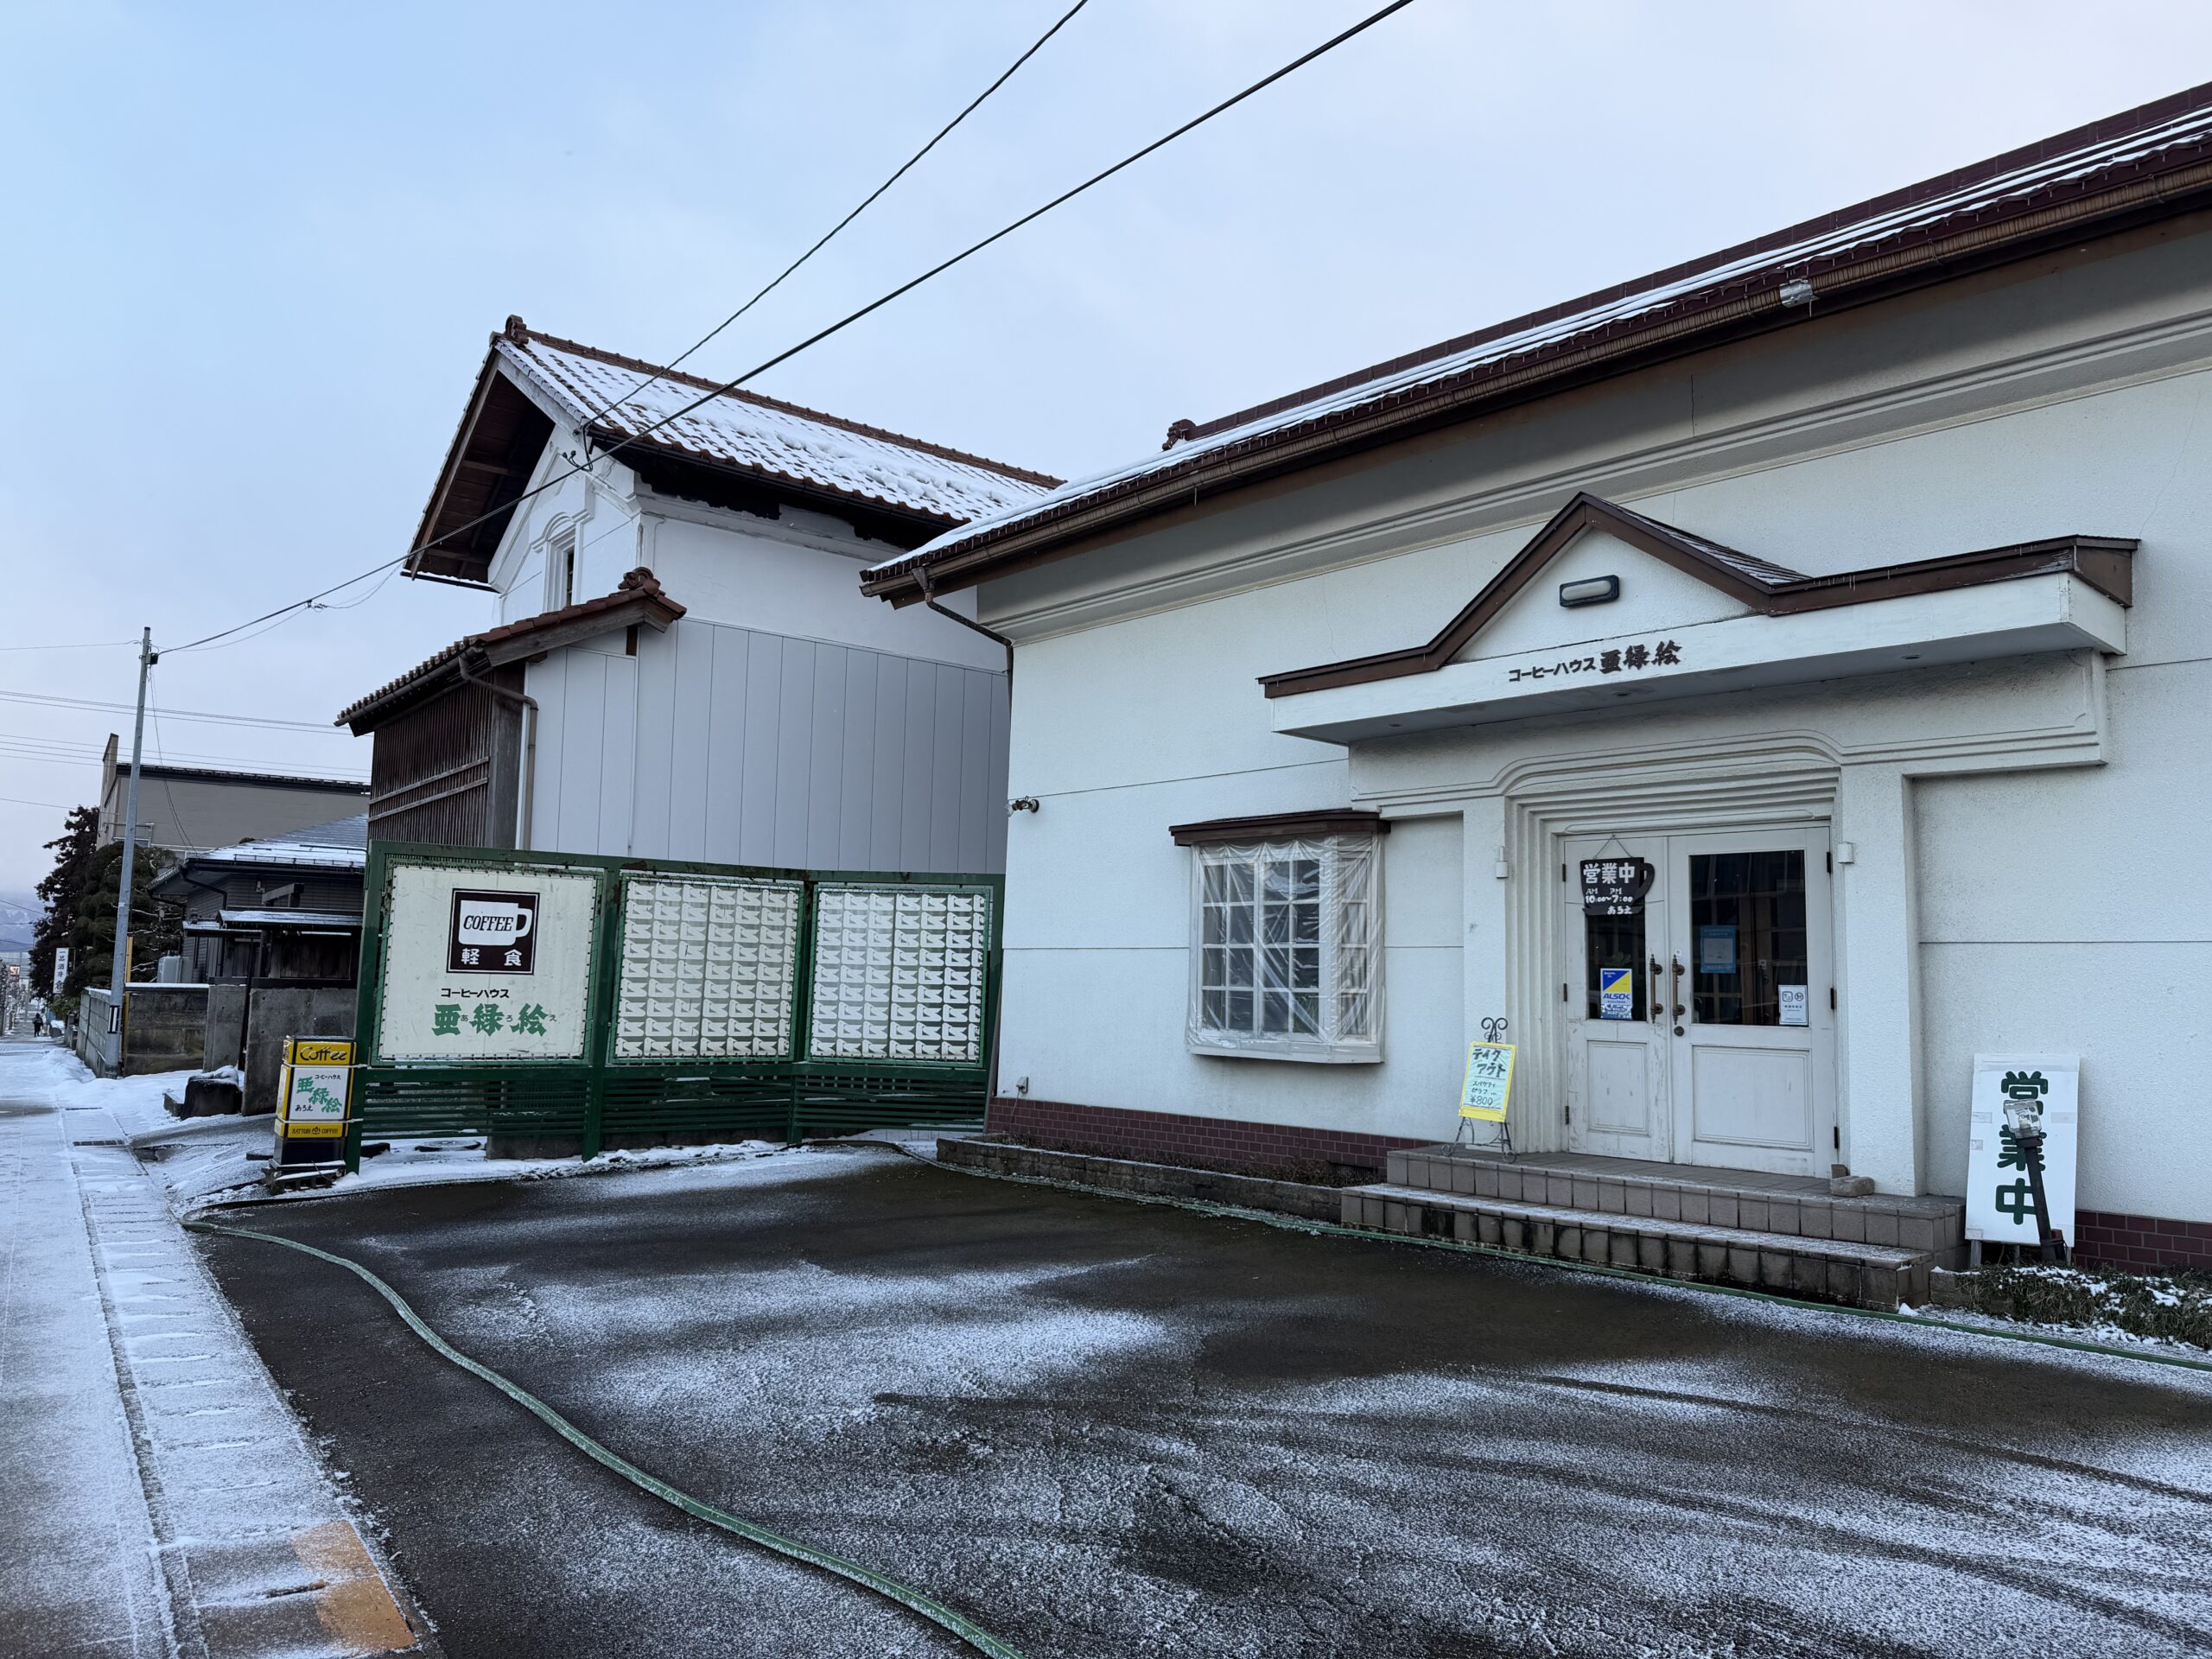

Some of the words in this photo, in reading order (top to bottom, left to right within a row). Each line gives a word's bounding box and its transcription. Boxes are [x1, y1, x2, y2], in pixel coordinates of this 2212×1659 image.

[1509, 657, 1597, 682] コーヒーハウス
[1599, 639, 1682, 674] 亜緑絵
[1583, 861, 1635, 884] 営業中
[1607, 905, 1633, 915] あろえ
[463, 915, 514, 931] COFFEE
[461, 948, 522, 966] 軽食
[441, 988, 510, 998] コーヒーハウス
[300, 1046, 347, 1061] Coffee
[1472, 1048, 1502, 1061] テイク
[1477, 1063, 1506, 1078] アウト
[1470, 1095, 1493, 1106] ¥800
[1995, 1071, 2048, 1225] 営業中
